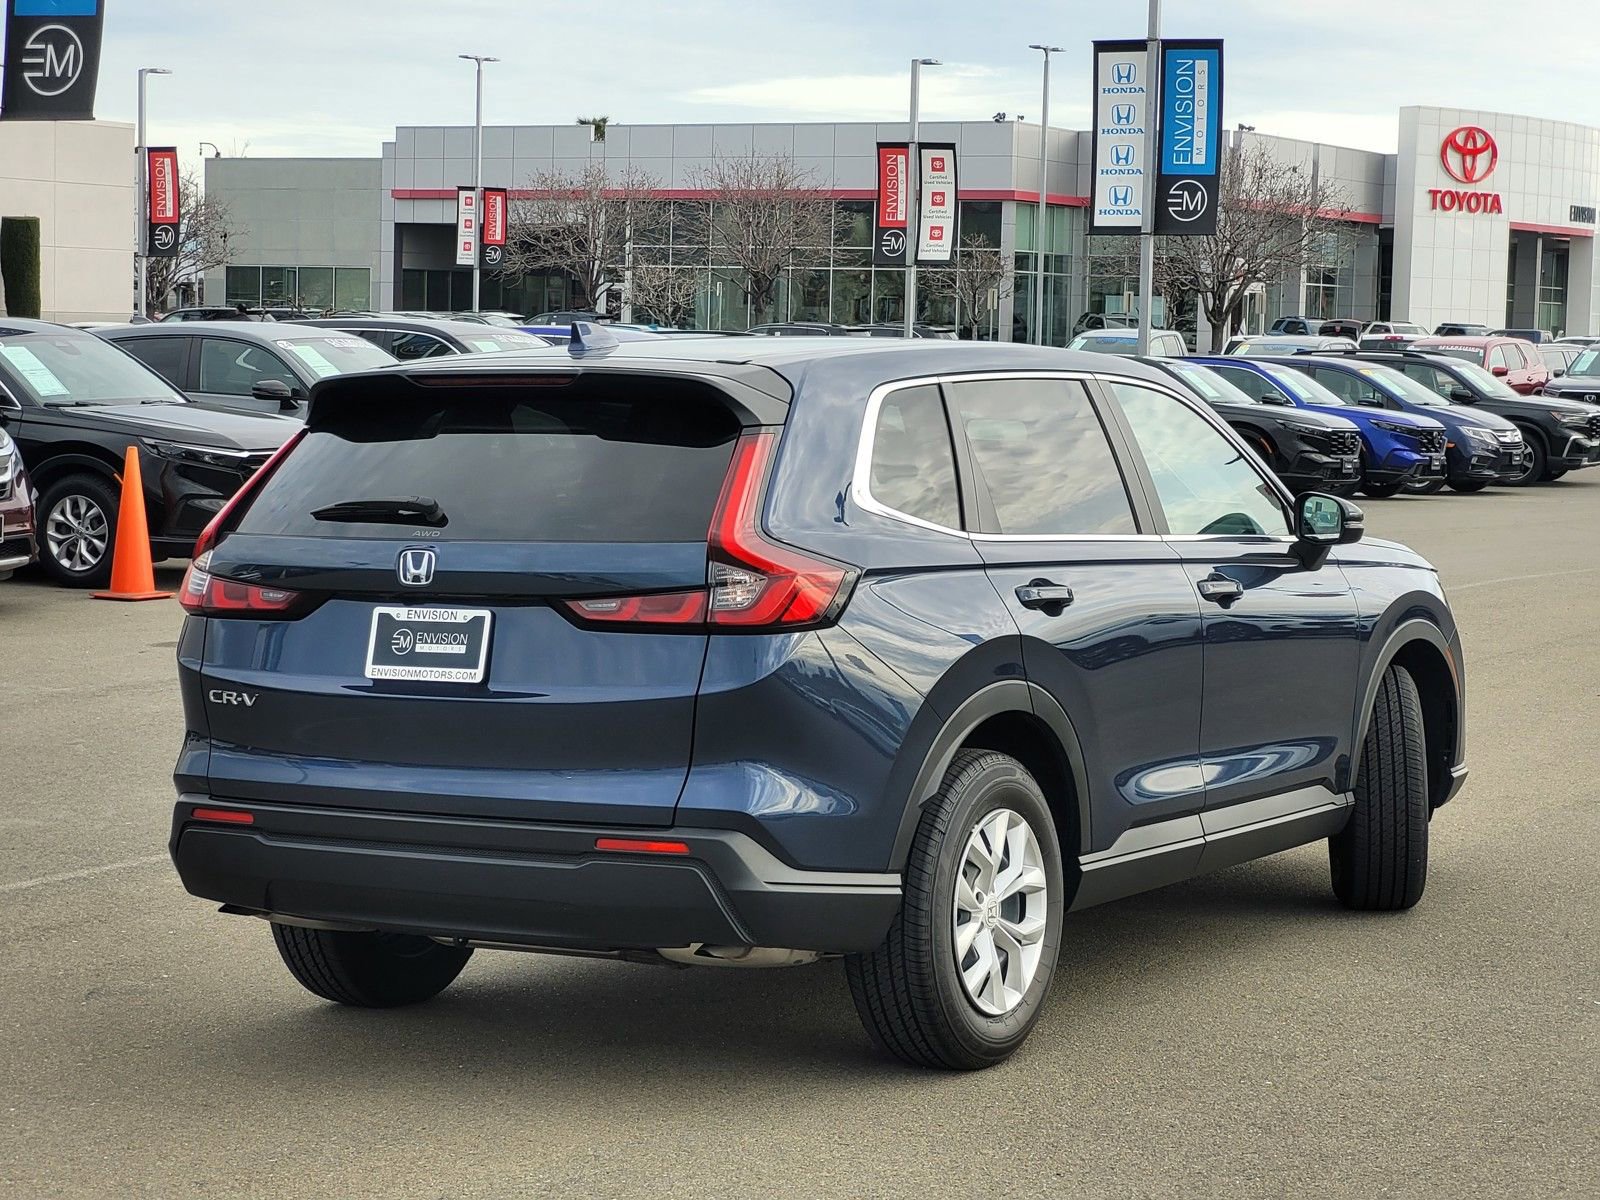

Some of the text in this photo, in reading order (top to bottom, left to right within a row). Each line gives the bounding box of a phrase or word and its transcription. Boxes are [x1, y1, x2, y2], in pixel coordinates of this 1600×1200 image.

[1172, 59, 1194, 165] ENVISION
[1196, 69, 1205, 156] MOTORS
[155, 157, 166, 218] ENVISION
[886, 154, 898, 221] ENVISION
[1428, 189, 1503, 214] TOYOTA
[488, 195, 496, 240] ENVISION
[406, 609, 458, 621] ENVISION
[416, 632, 468, 645] ENVISION
[370, 667, 477, 681] ENVISIONMOTORS.COM
[208, 689, 259, 707] CR-V
